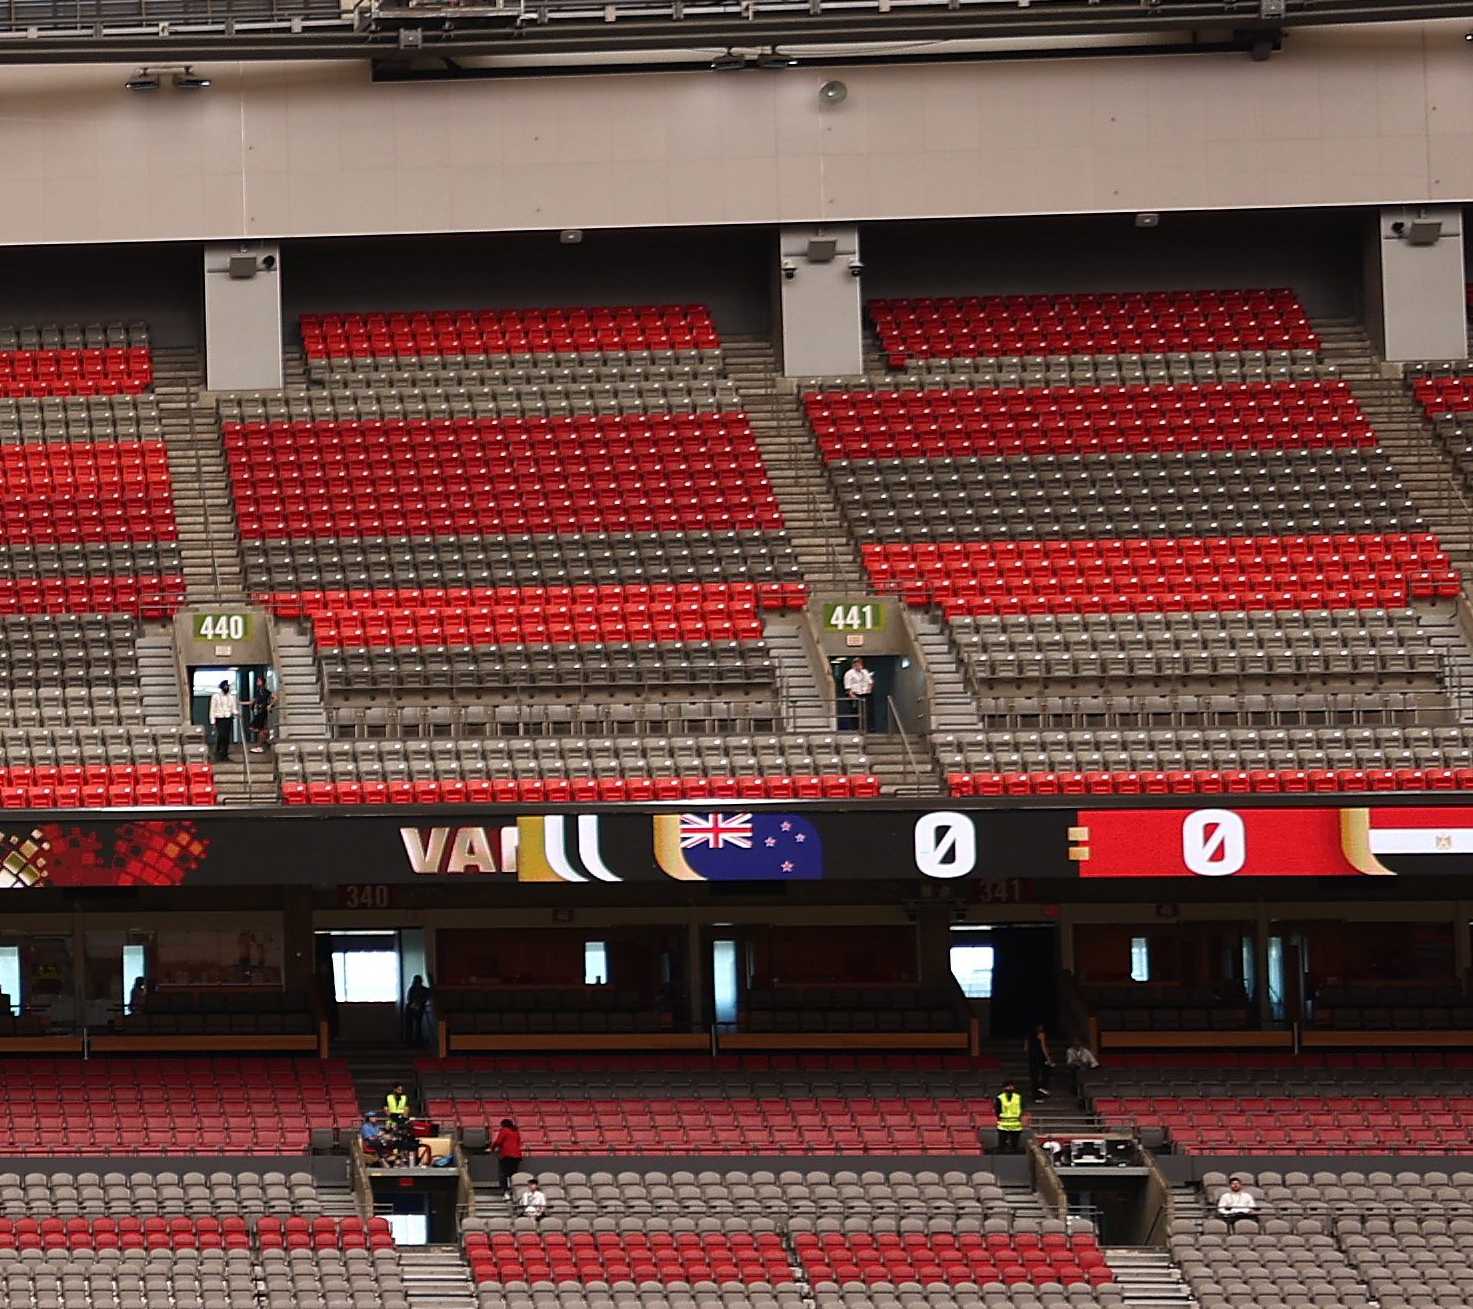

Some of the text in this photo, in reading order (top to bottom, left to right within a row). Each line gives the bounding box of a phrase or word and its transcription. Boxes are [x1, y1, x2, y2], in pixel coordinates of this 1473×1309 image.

[200, 615, 244, 639] 440
[830, 605, 872, 629] 441
[346, 885, 389, 908] 340
[980, 879, 1021, 903] 341
